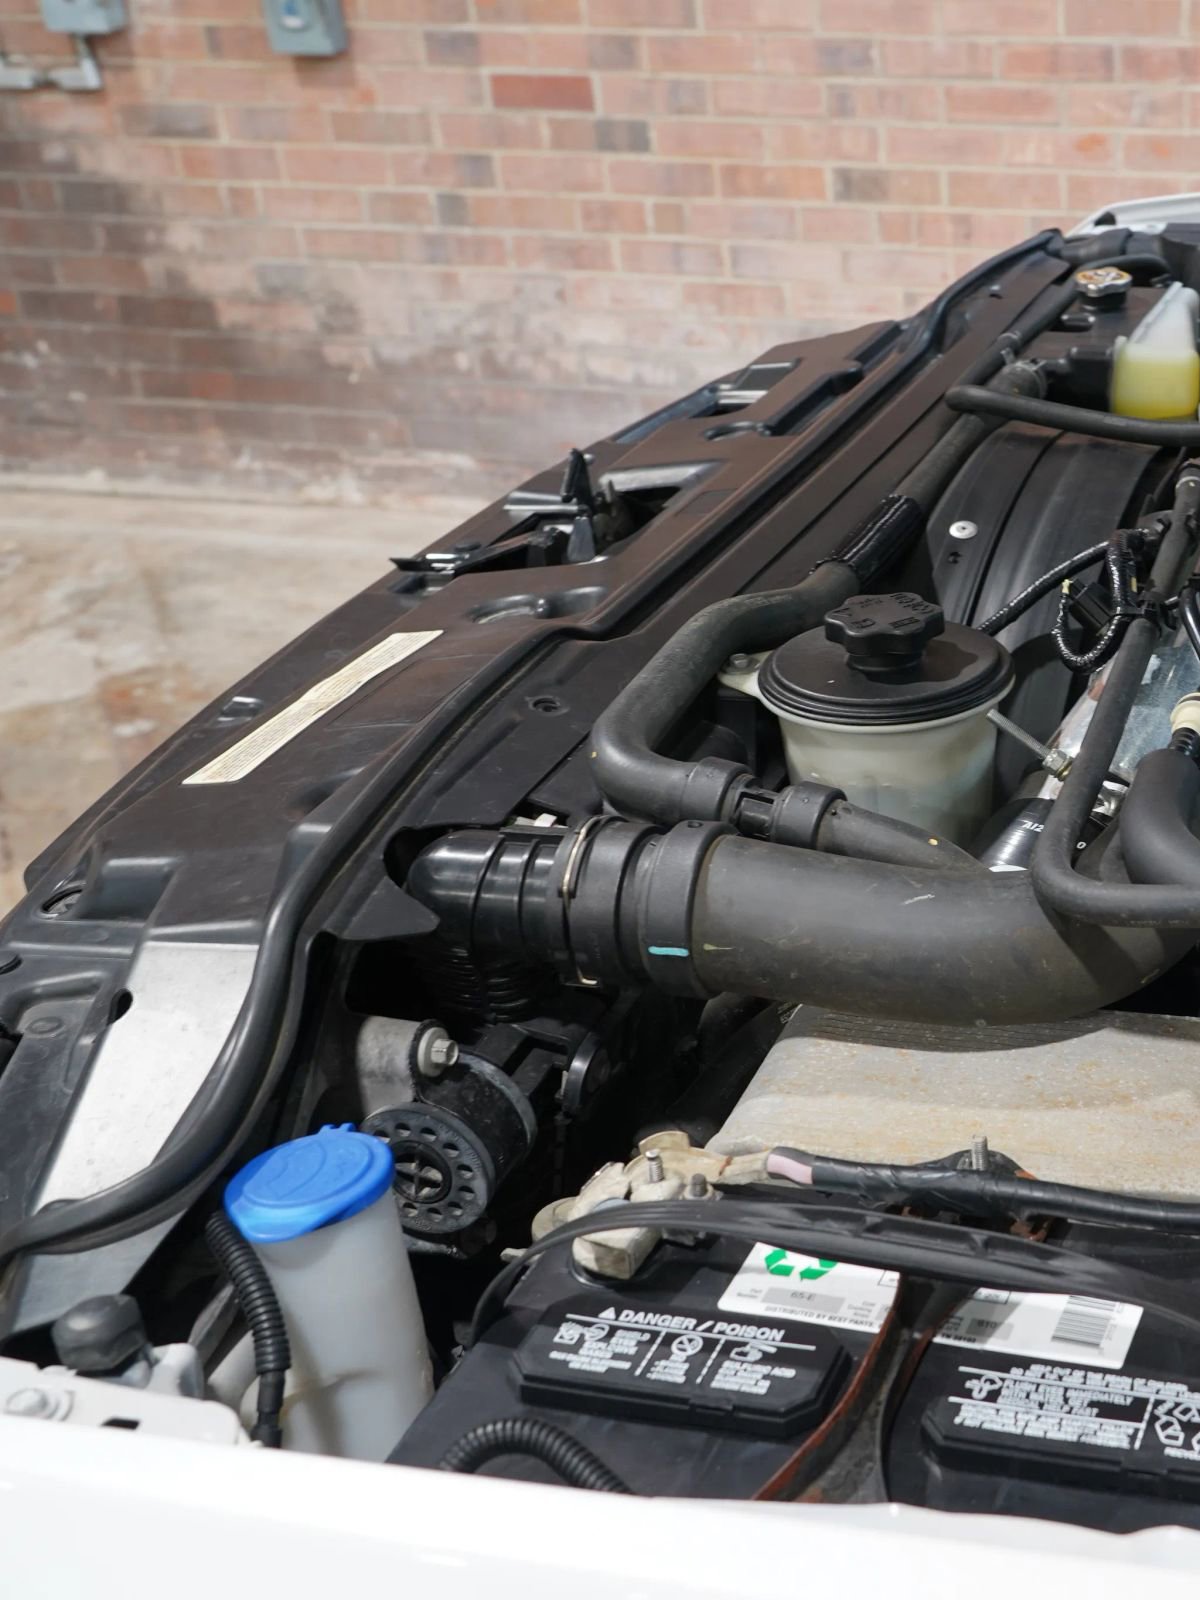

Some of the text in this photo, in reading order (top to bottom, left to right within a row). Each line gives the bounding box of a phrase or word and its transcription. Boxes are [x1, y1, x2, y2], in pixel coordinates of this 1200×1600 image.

[619, 1309, 697, 1331] DANGER
[712, 1321, 785, 1342] POISON
[764, 1306, 814, 1319] DISTRIBUTED
[816, 1312, 827, 1321] BY
[828, 1313, 848, 1324] BEST
